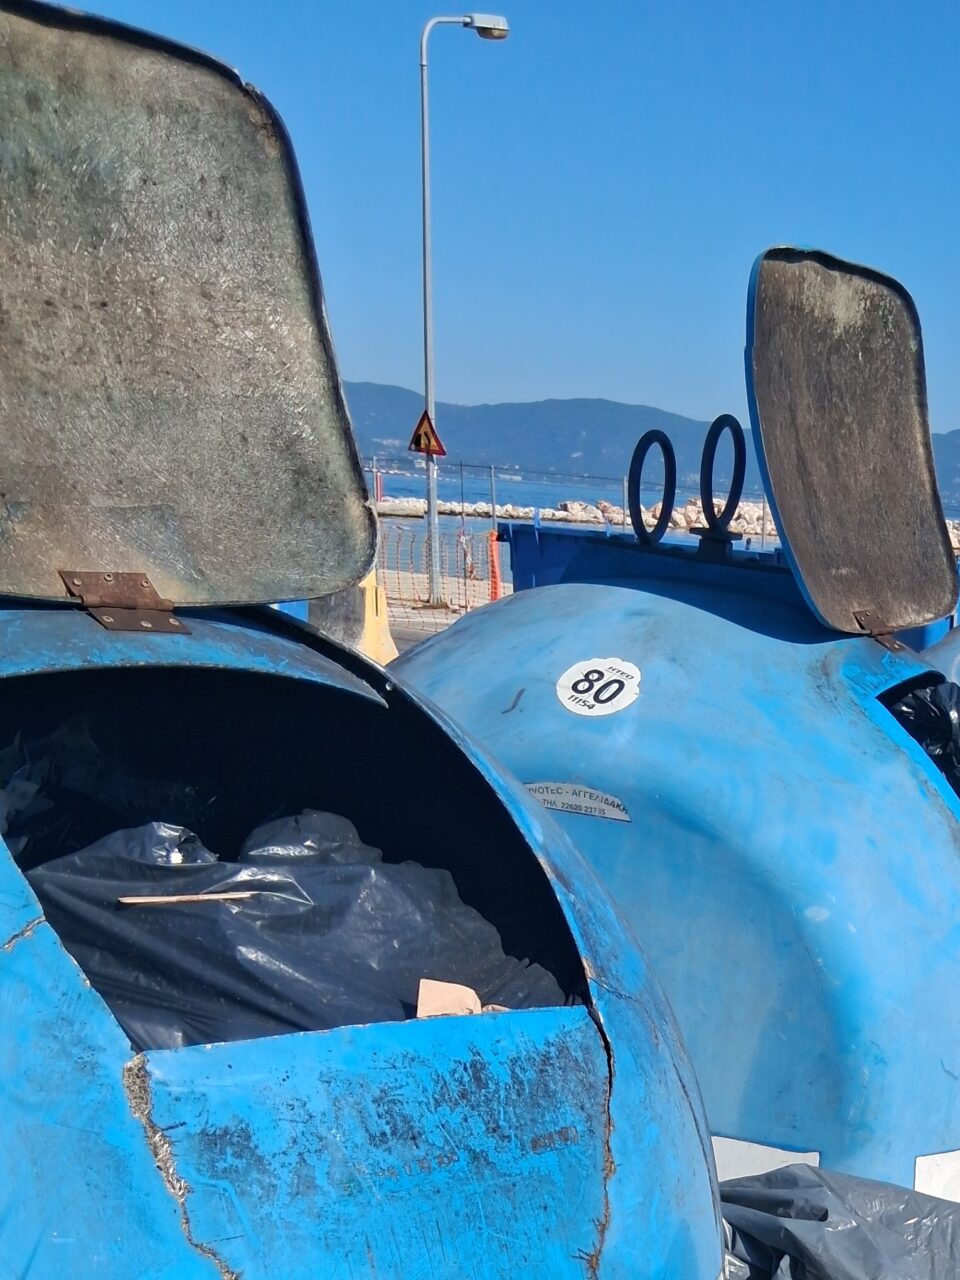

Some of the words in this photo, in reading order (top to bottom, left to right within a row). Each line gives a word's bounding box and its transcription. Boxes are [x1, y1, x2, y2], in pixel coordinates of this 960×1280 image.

[571, 669, 626, 706] 80
[567, 694, 597, 710] 11154
[561, 802, 583, 811] 22620
